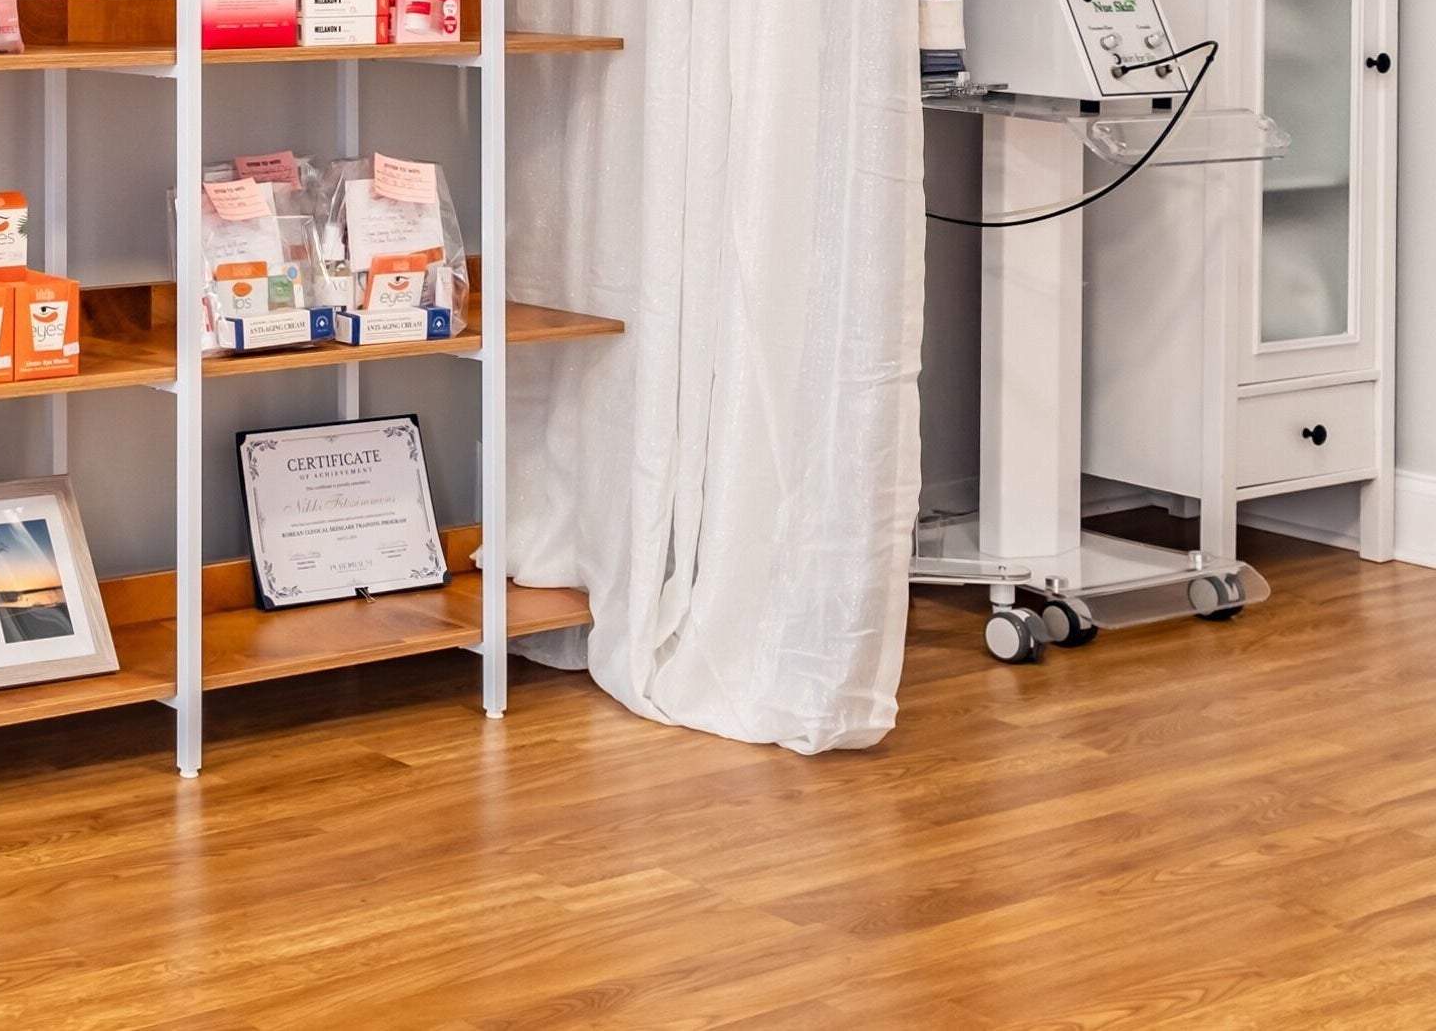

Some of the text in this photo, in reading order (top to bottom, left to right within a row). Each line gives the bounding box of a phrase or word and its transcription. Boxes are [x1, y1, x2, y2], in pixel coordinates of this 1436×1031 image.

[1093, 1, 1135, 12] Nue Skin
[380, 291, 412, 306] eyes
[250, 321, 306, 334] ANTI-AGING CREAM
[366, 321, 422, 332] ANTI-AGING CREAM
[287, 450, 382, 471] CERTIFICATE
[314, 468, 373, 478] ACHIEVEMENT
